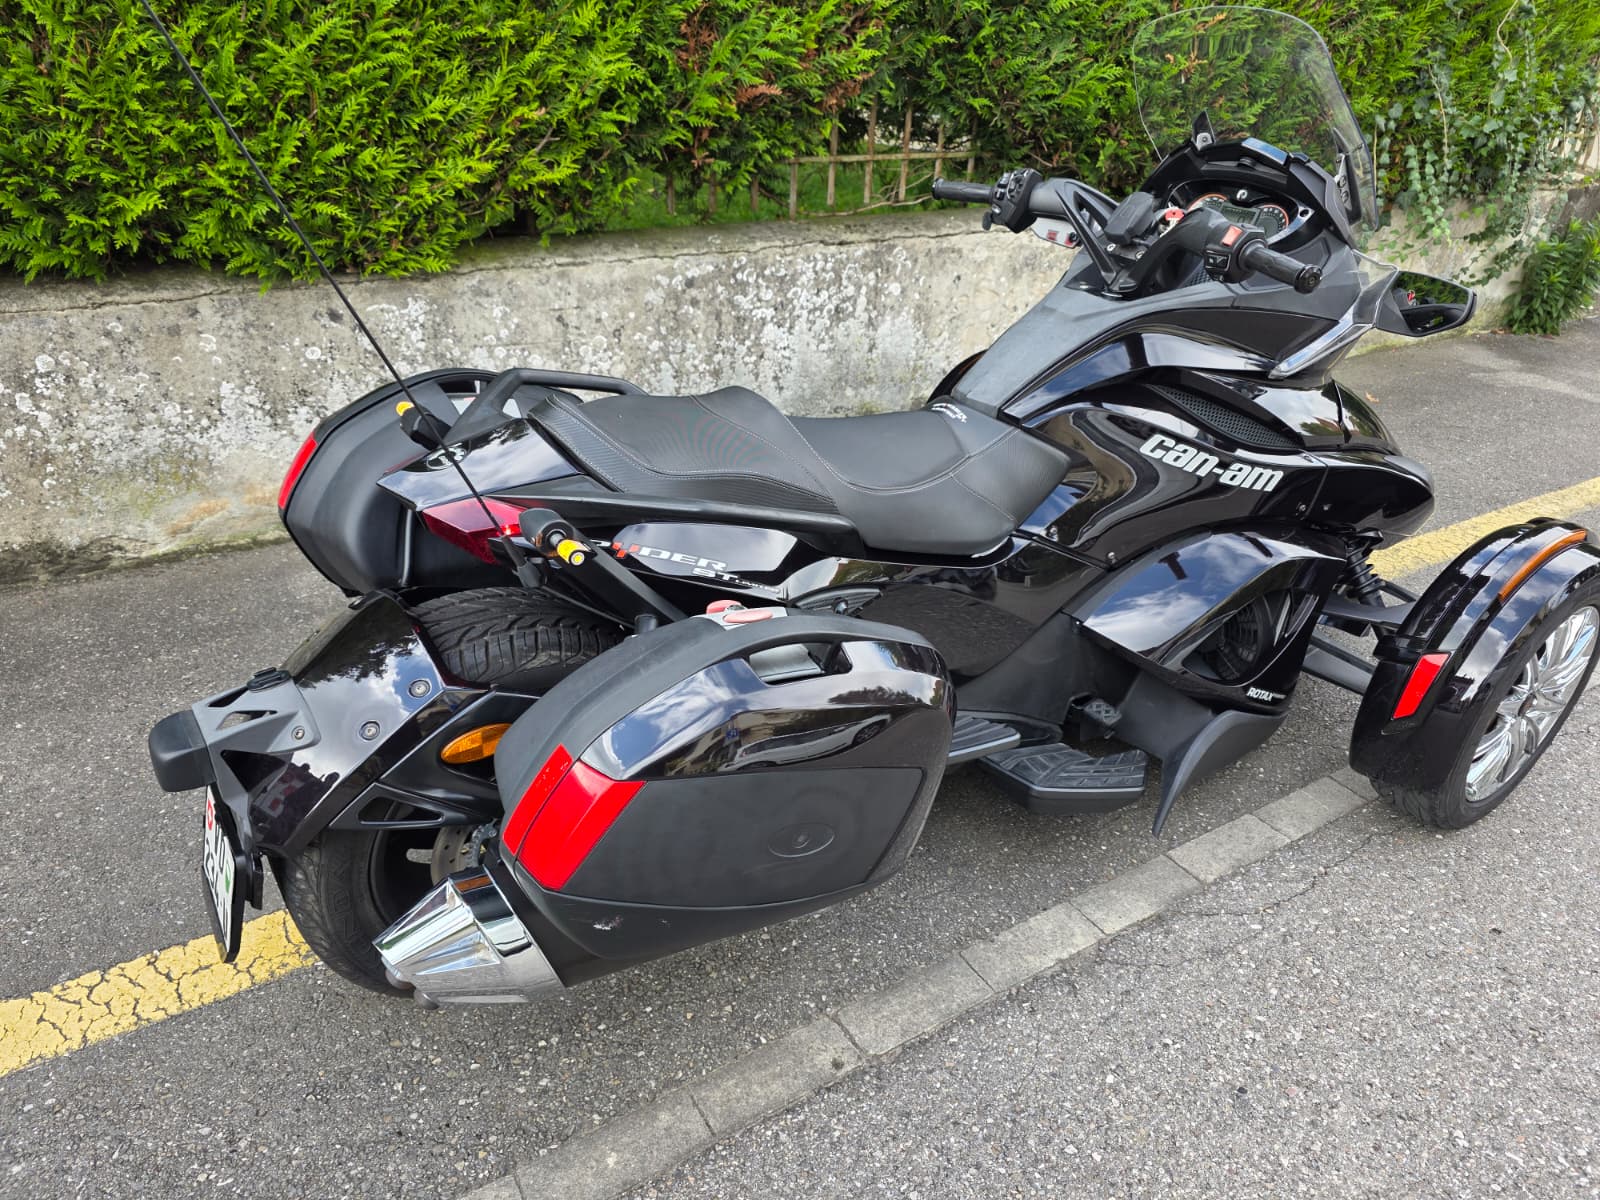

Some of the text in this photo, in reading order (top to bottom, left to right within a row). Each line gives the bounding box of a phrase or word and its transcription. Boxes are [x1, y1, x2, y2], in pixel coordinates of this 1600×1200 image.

[590, 539, 728, 571] PYDER
[692, 567, 738, 581] ST
[1246, 686, 1273, 702] ROTAX
